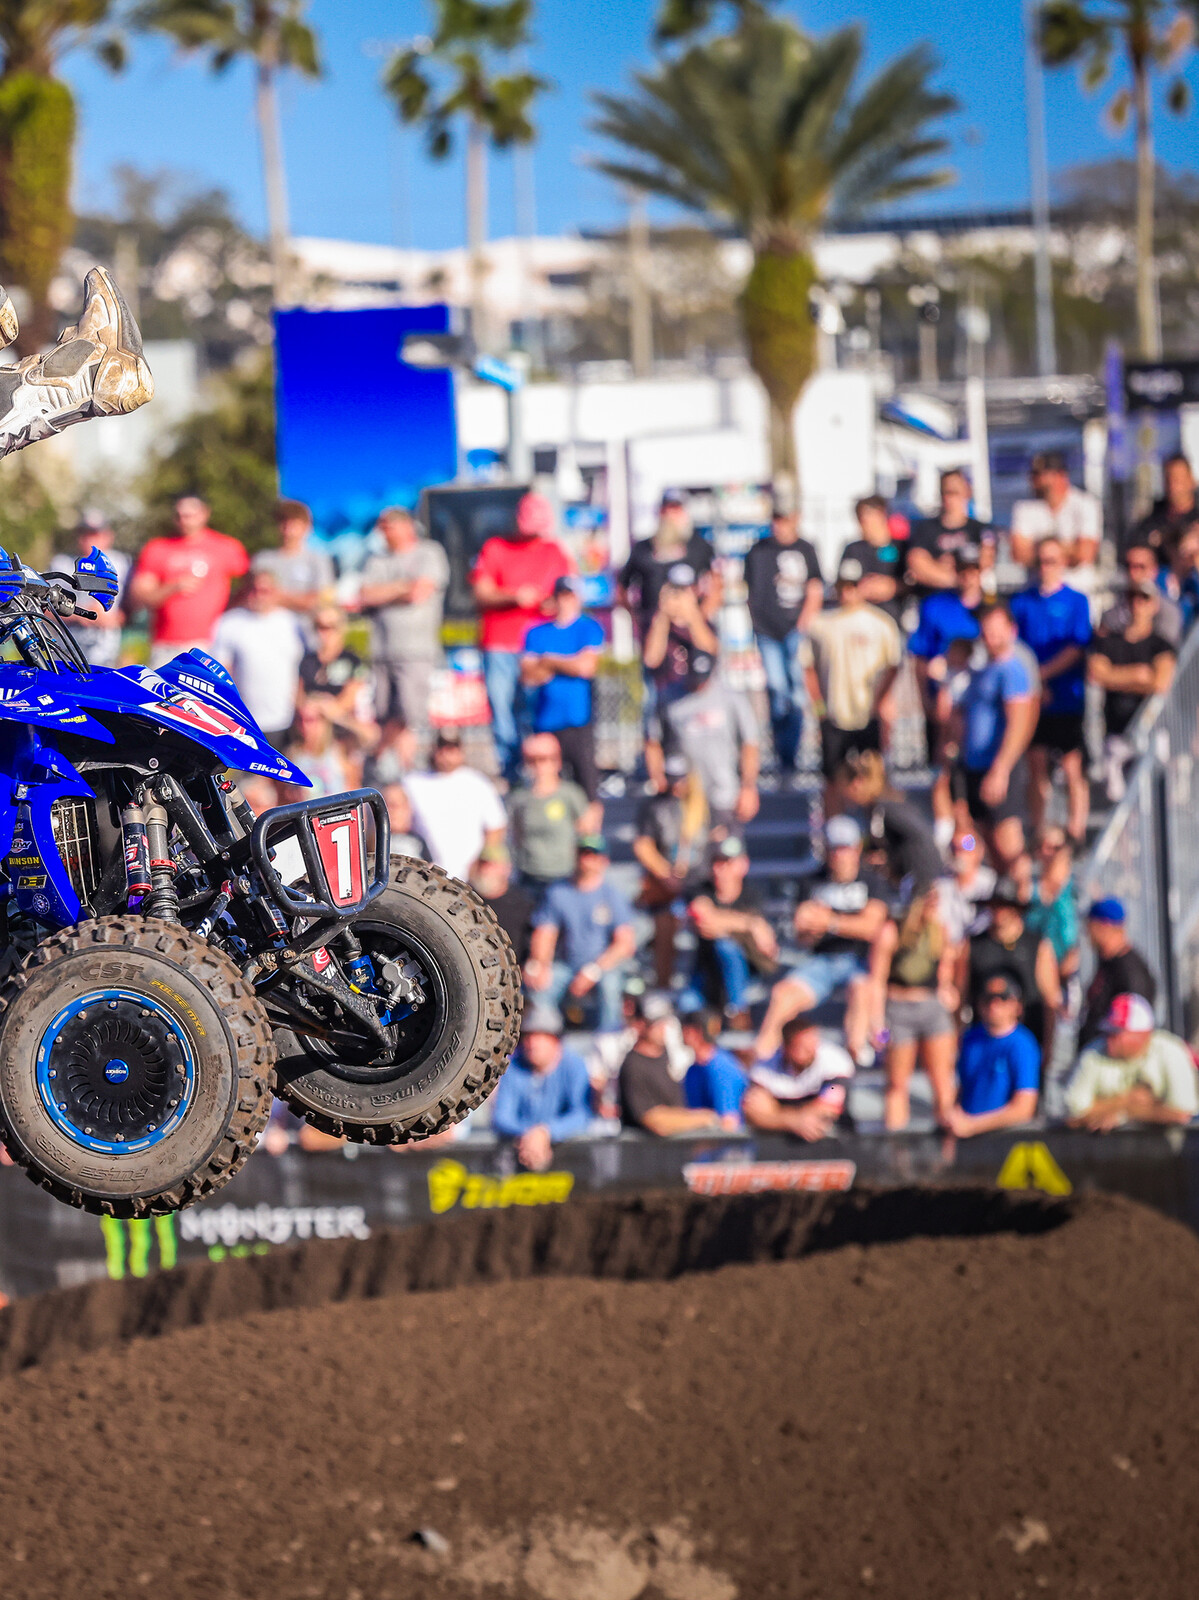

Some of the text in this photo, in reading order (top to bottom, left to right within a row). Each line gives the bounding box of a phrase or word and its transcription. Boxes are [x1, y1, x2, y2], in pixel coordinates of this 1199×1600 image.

[249, 762, 279, 774] Elka
[331, 825, 353, 899] 1
[80, 961, 145, 982] CST
[150, 978, 190, 1011] PULSE
[180, 1203, 371, 1246] MONSTER
